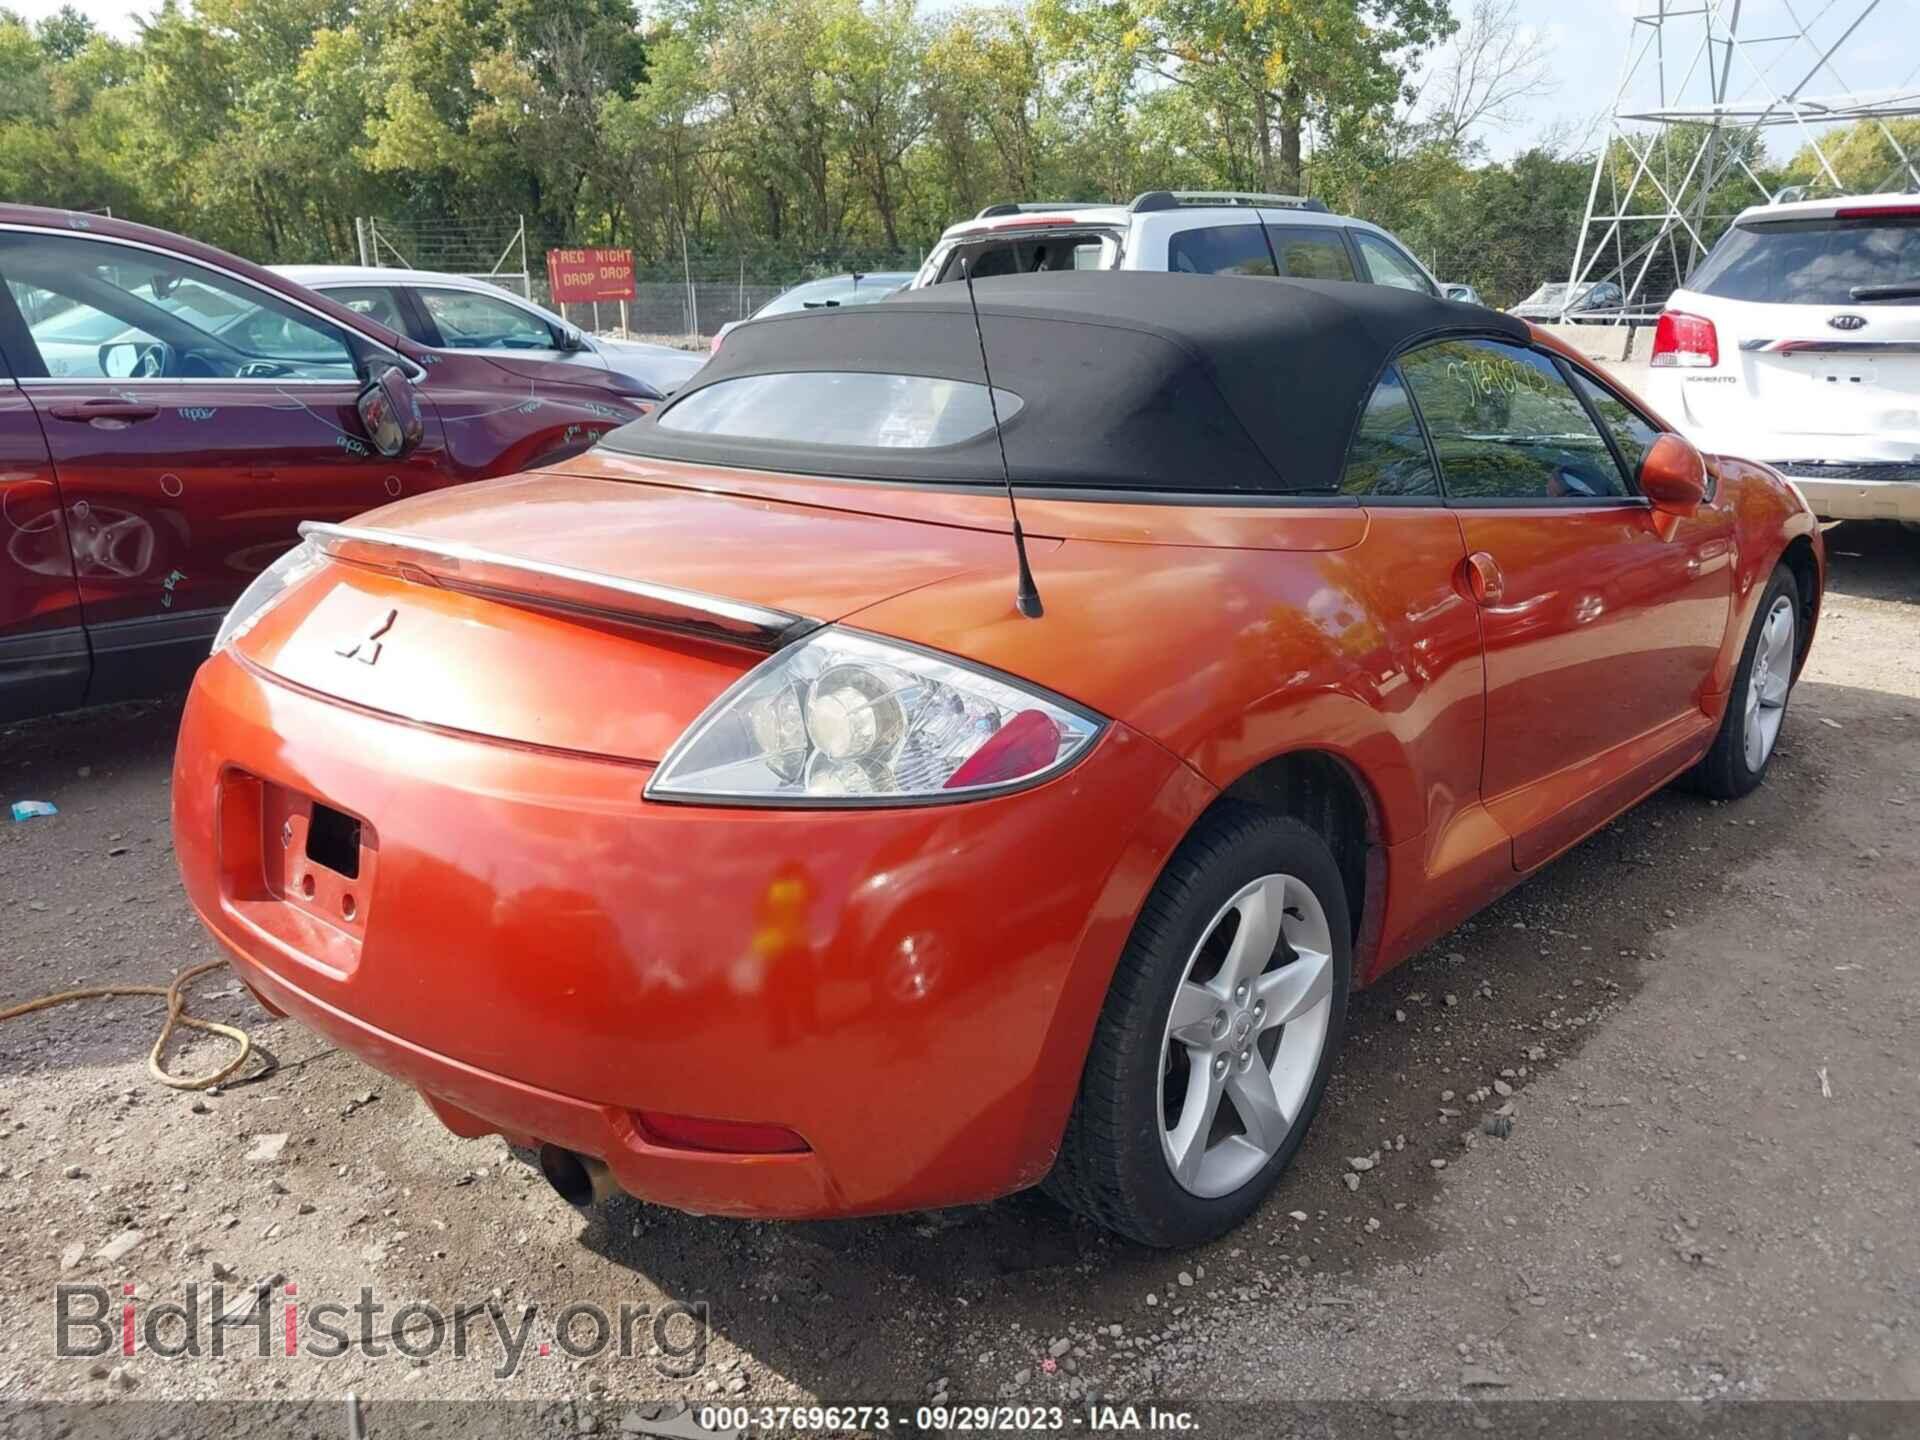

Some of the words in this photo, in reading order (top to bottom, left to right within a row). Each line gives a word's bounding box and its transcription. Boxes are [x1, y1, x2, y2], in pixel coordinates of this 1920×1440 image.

[595, 250, 633, 263] NIGHT
[563, 272, 595, 287] DROP
[599, 266, 631, 280] DROP
[1833, 315, 1862, 330] KIA
